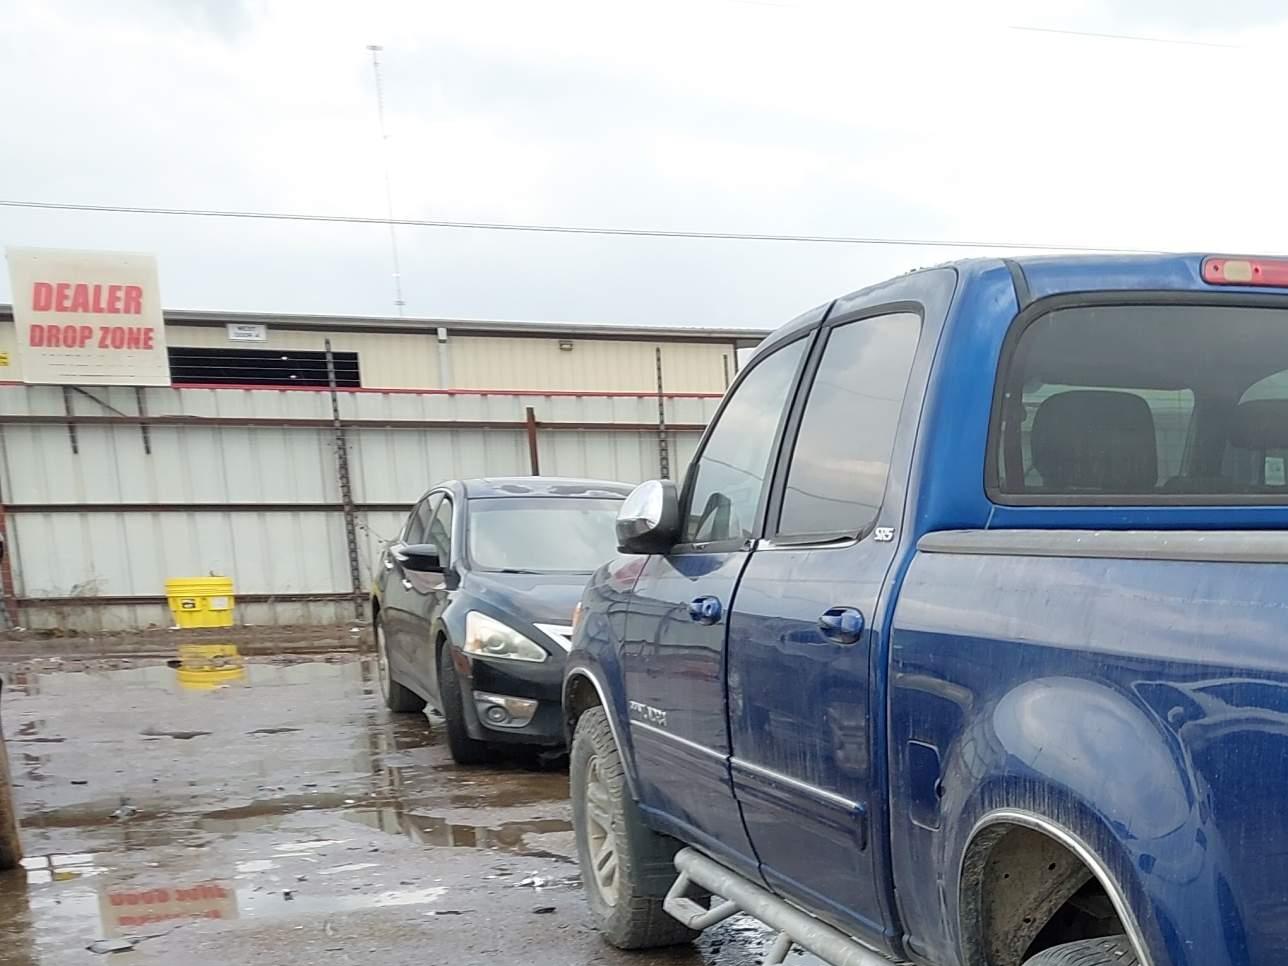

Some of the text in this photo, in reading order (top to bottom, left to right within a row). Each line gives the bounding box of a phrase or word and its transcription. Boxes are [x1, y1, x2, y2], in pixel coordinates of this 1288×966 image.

[32, 282, 143, 315] DEALER
[29, 324, 155, 350] DROP ZONE
